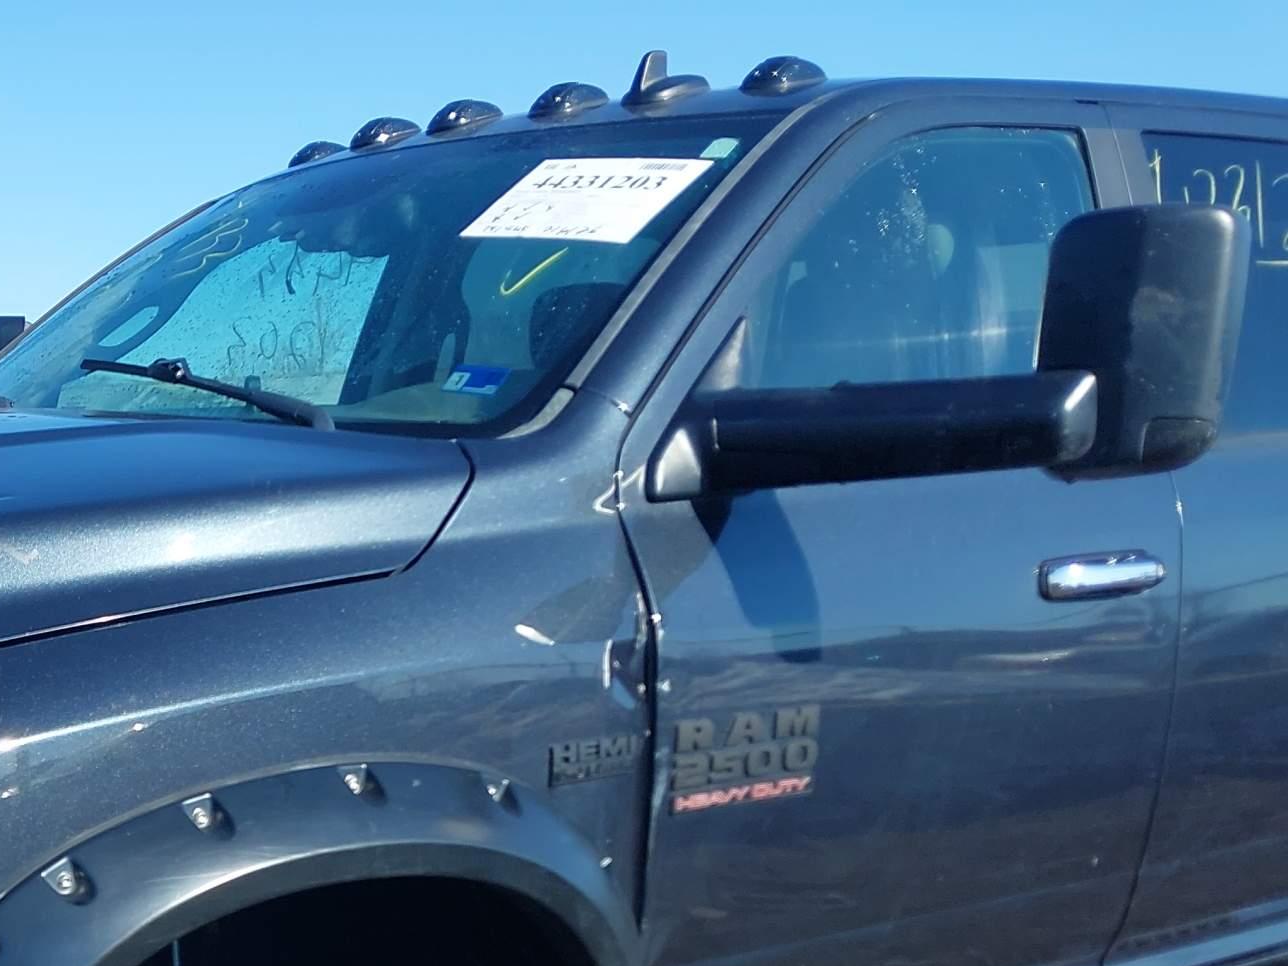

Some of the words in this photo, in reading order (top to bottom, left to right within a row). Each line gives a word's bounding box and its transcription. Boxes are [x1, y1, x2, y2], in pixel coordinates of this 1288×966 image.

[532, 174, 668, 190] 44331203
[673, 704, 821, 752] RAM
[549, 735, 638, 764] HEMI
[670, 738, 819, 790] 2500
[674, 785, 750, 813] HEAVY
[750, 776, 812, 798] DUTY
